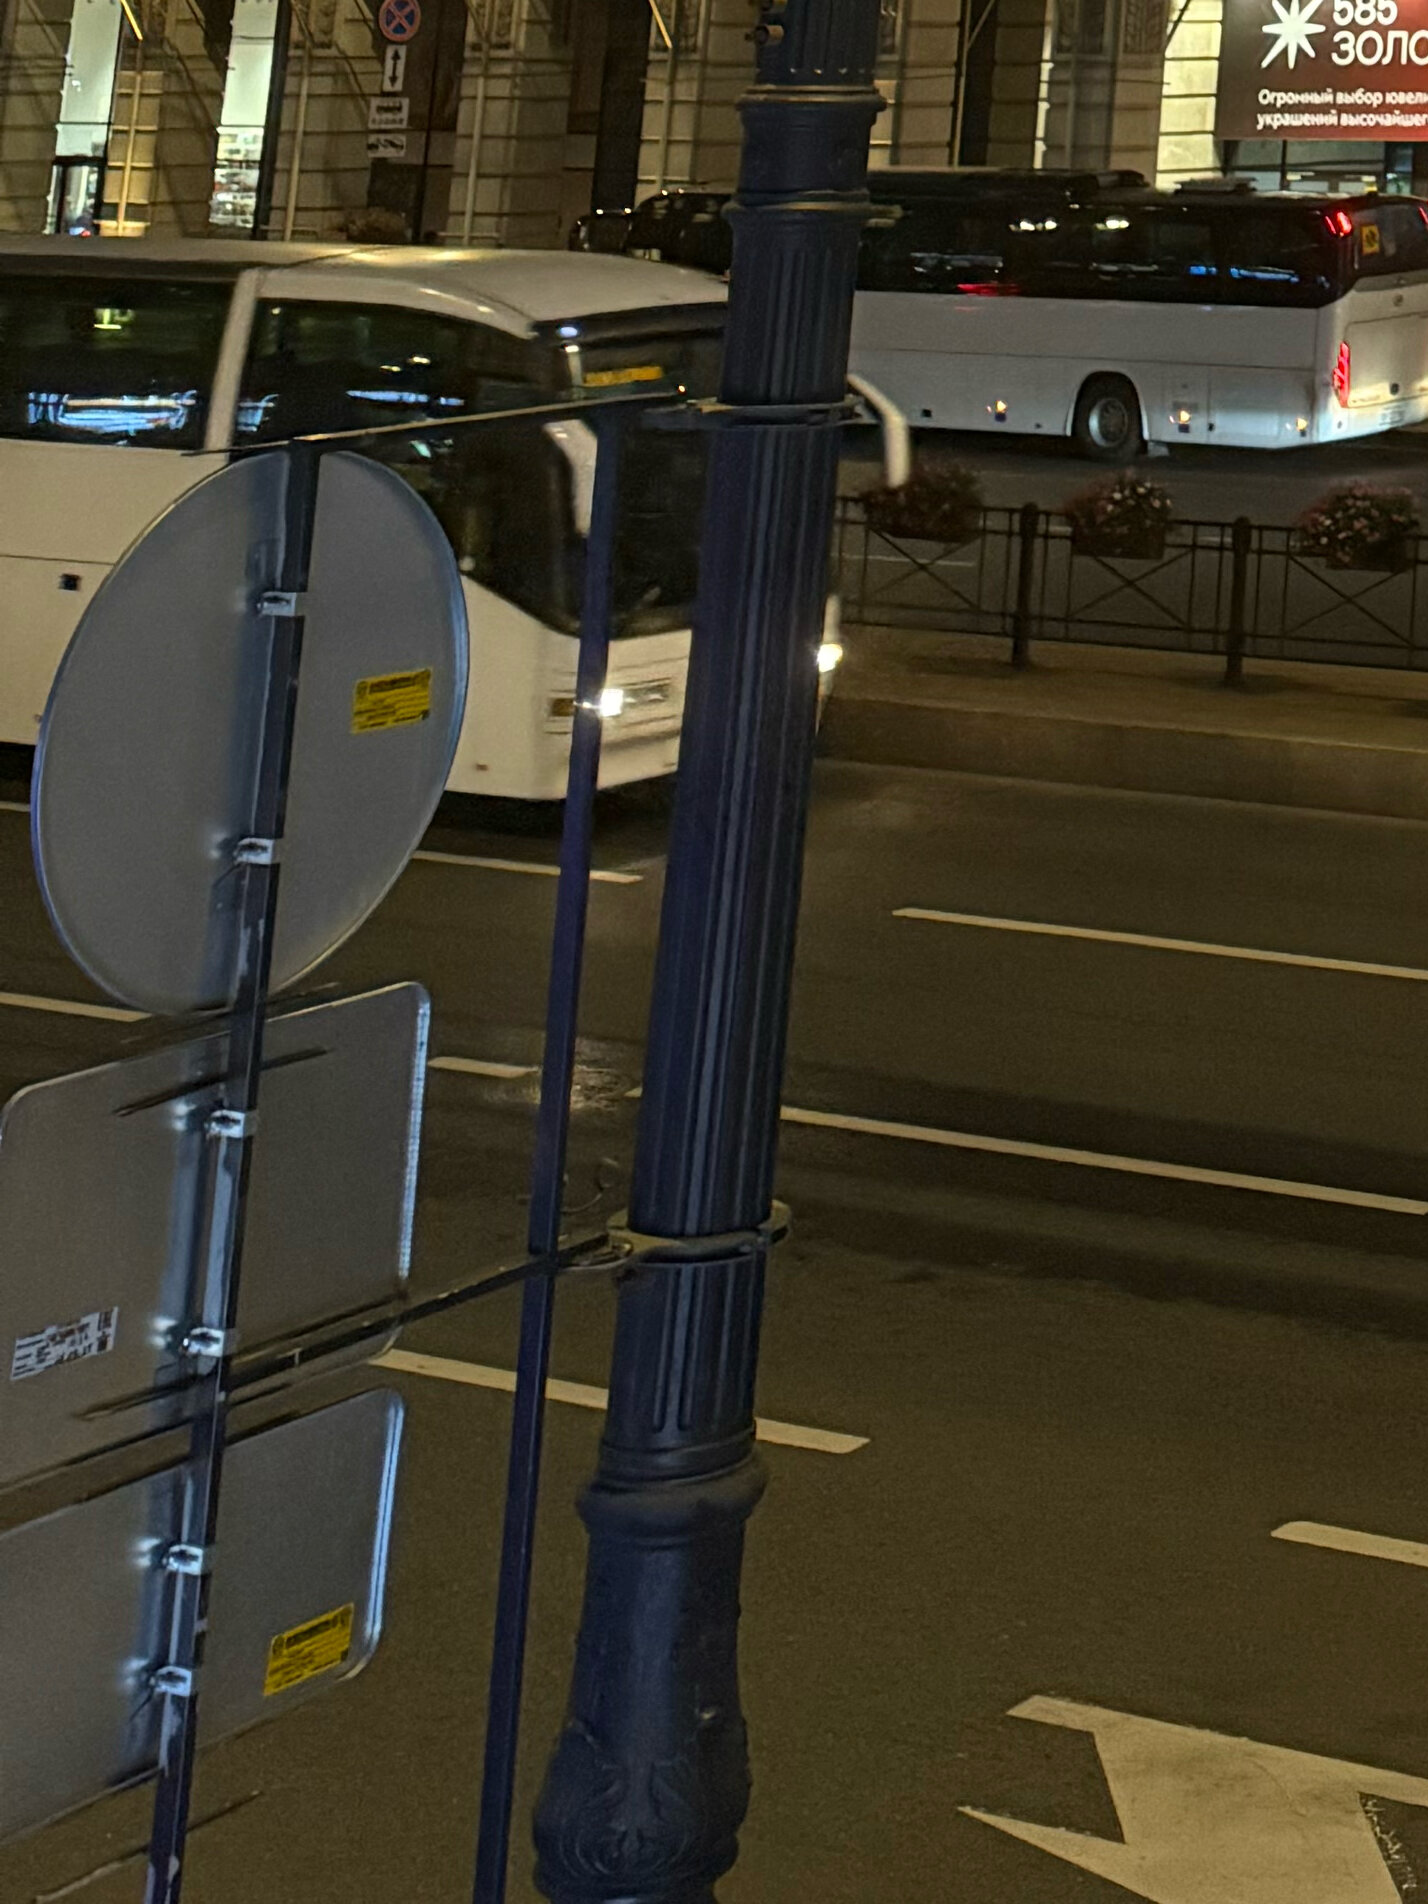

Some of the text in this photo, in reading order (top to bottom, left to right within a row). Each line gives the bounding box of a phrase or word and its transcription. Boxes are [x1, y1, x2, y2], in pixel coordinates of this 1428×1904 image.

[1258, 88, 1334, 108] Огромный
[1336, 88, 1383, 108] выбор
[1256, 110, 1338, 130] украшений
